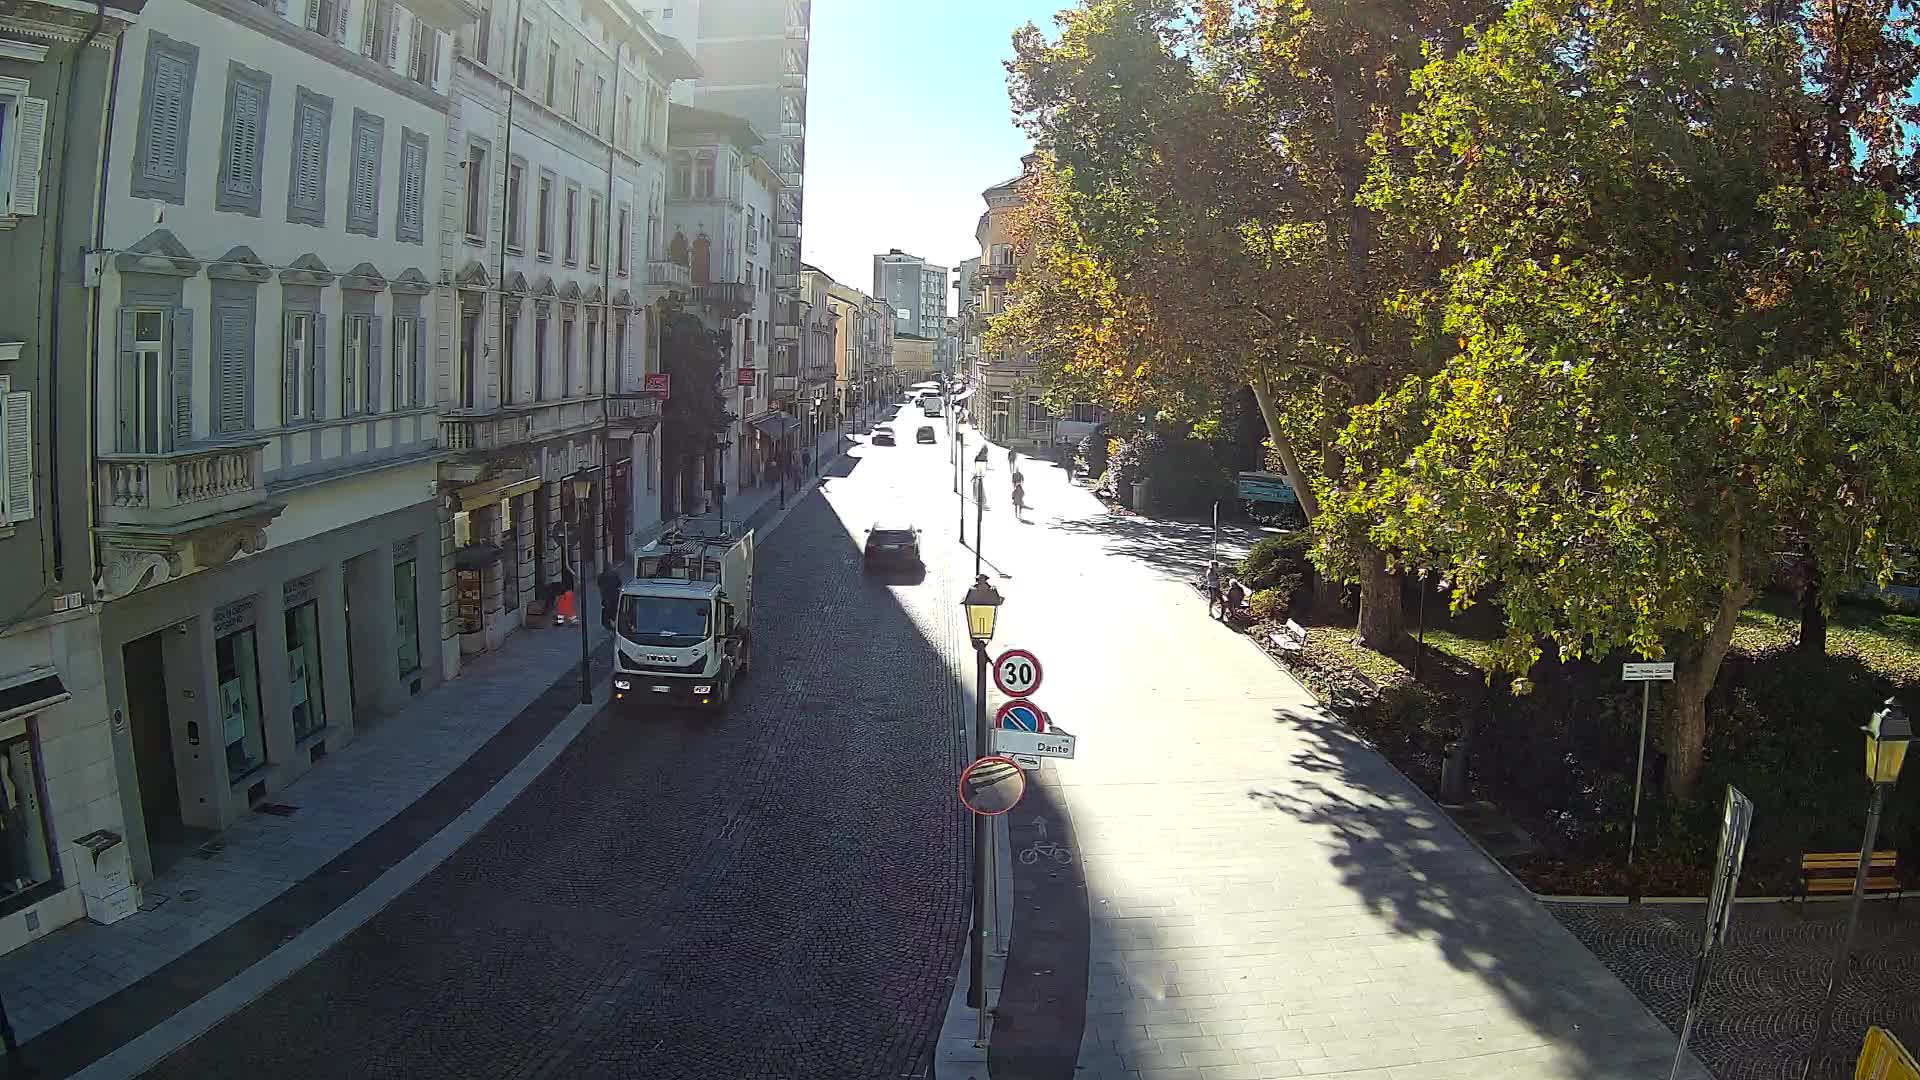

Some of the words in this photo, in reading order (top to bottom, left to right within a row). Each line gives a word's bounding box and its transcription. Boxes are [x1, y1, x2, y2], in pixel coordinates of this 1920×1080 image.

[646, 654, 678, 662] IVECO
[1005, 663, 1032, 685] 30
[1037, 742, 1069, 753] Dante
